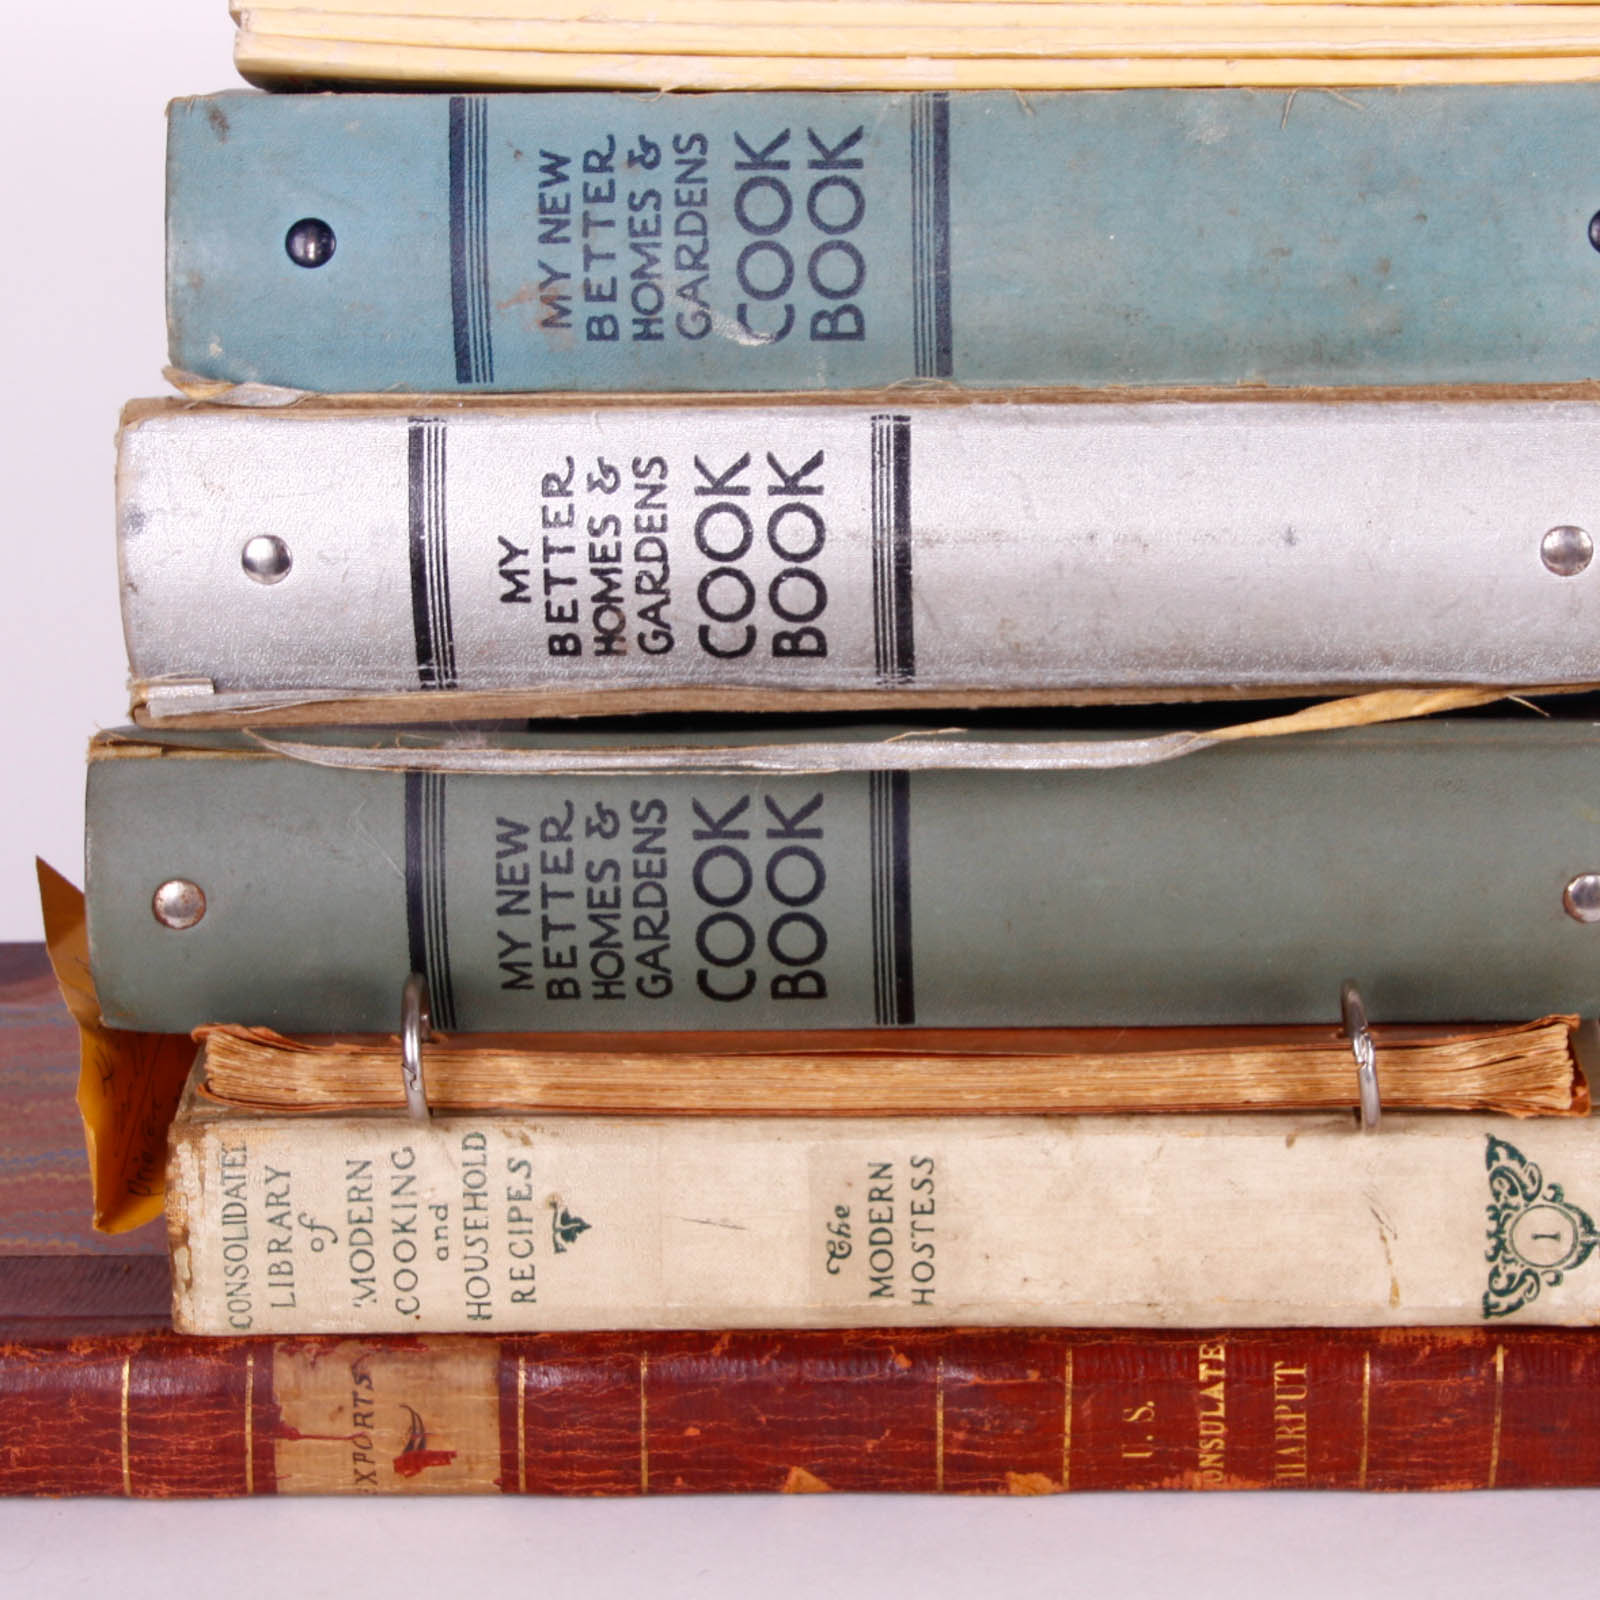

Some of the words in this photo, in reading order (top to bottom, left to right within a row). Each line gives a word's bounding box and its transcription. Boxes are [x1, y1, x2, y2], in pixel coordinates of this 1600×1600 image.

[538, 149, 572, 245] NEW
[627, 134, 662, 170] &
[538, 261, 572, 329] MY
[583, 134, 619, 342] BETTER
[628, 187, 664, 342] HOMES
[674, 132, 712, 340] GARDENS
[734, 127, 795, 345] COOK
[807, 125, 866, 342] BOOK
[587, 457, 622, 495] &
[498, 536, 532, 604] MY
[542, 456, 582, 657] BETTER
[587, 513, 627, 657] HOMES
[632, 456, 674, 655] GARDENS
[694, 452, 757, 658] COOK
[766, 450, 828, 658] BOOK
[496, 816, 531, 915] NEW
[586, 801, 621, 840] &
[497, 930, 534, 991] MY
[540, 800, 581, 1000] BETTER
[587, 857, 627, 1000] HOMES
[631, 798, 674, 998] GARDENS
[692, 794, 756, 1002] COOK
[765, 792, 828, 1000] BOOK
[265, 1165, 297, 1309] LIBRARY
[299, 1212, 338, 1253] of
[346, 1159, 377, 1308] MODERN
[391, 1145, 420, 1316] COOKING
[435, 1203, 449, 1261] and
[462, 1131, 492, 1321] HOUSEHOLD
[507, 1156, 537, 1304] RECIPES
[826, 1205, 852, 1275] The
[867, 1162, 895, 1299] MODERN
[910, 1155, 935, 1306] HOSTESS
[352, 1371, 378, 1492] XPORTS
[1199, 1343, 1226, 1484] ONSULATE
